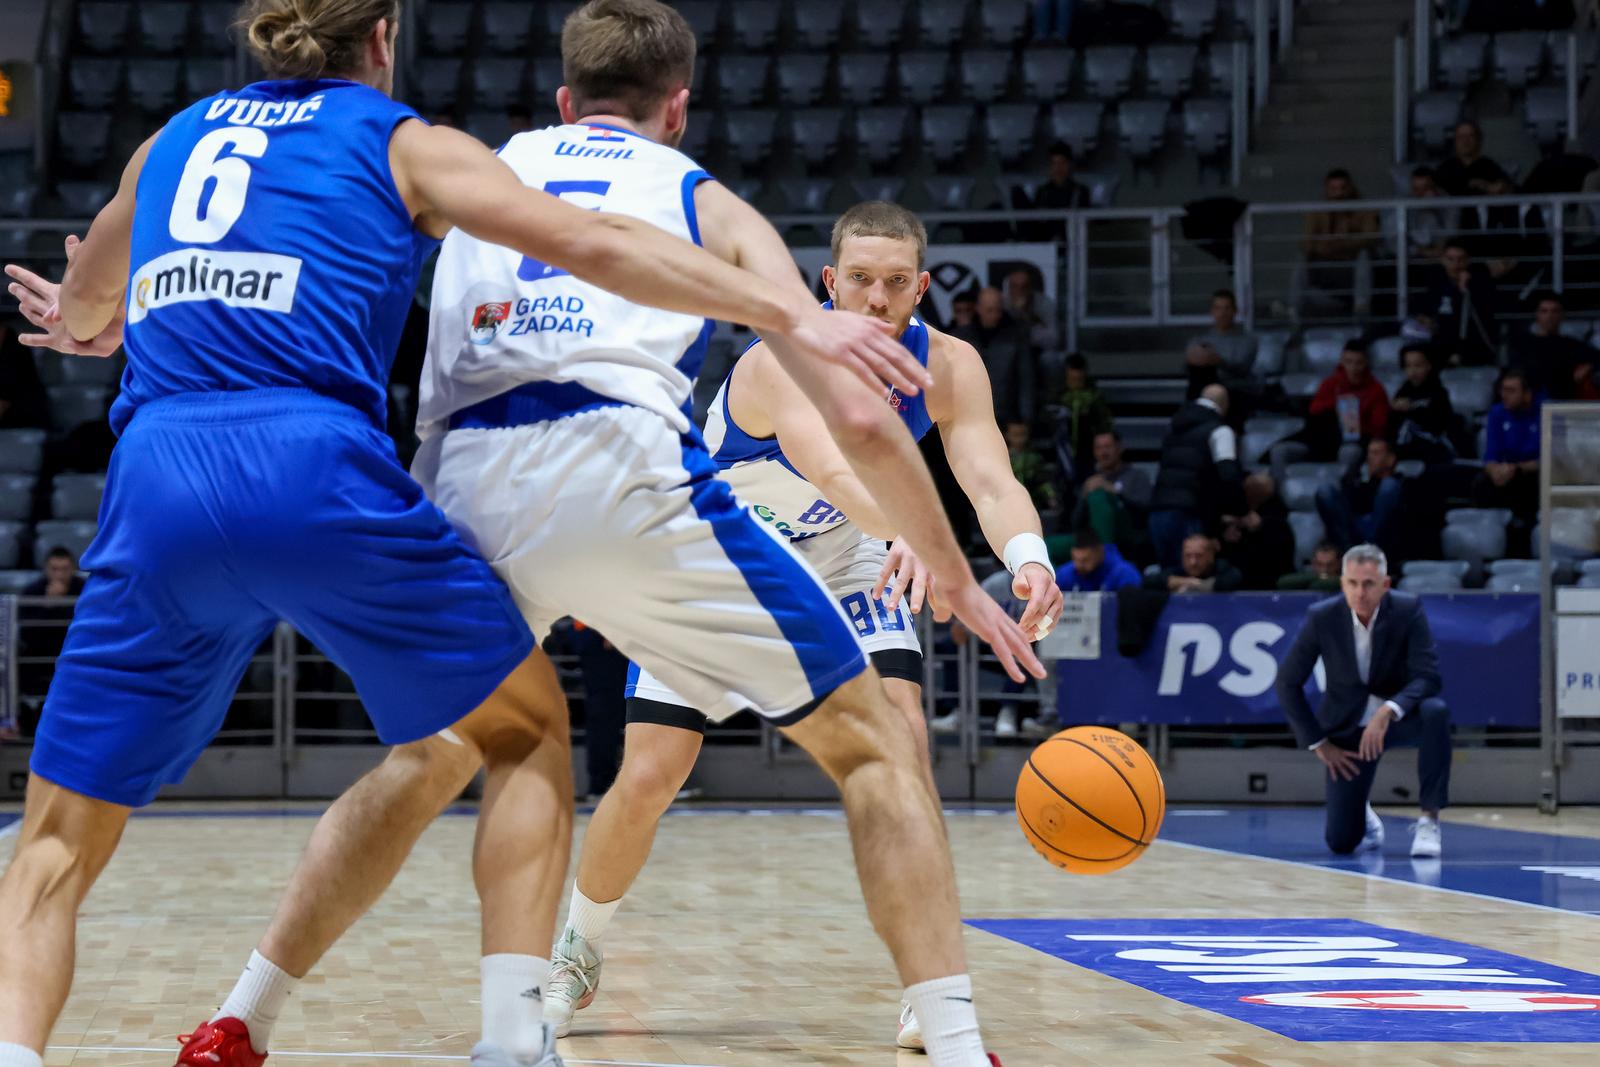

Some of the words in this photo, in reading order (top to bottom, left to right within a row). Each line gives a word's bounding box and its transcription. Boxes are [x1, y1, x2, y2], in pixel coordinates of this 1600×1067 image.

[204, 94, 325, 127] VUCIĆ
[554, 141, 635, 160] WAHL
[168, 126, 269, 244] 6
[154, 255, 283, 301] mlinar
[516, 296, 584, 316] GRAD
[509, 315, 594, 338] ZADAR
[1158, 620, 1327, 698] PS
